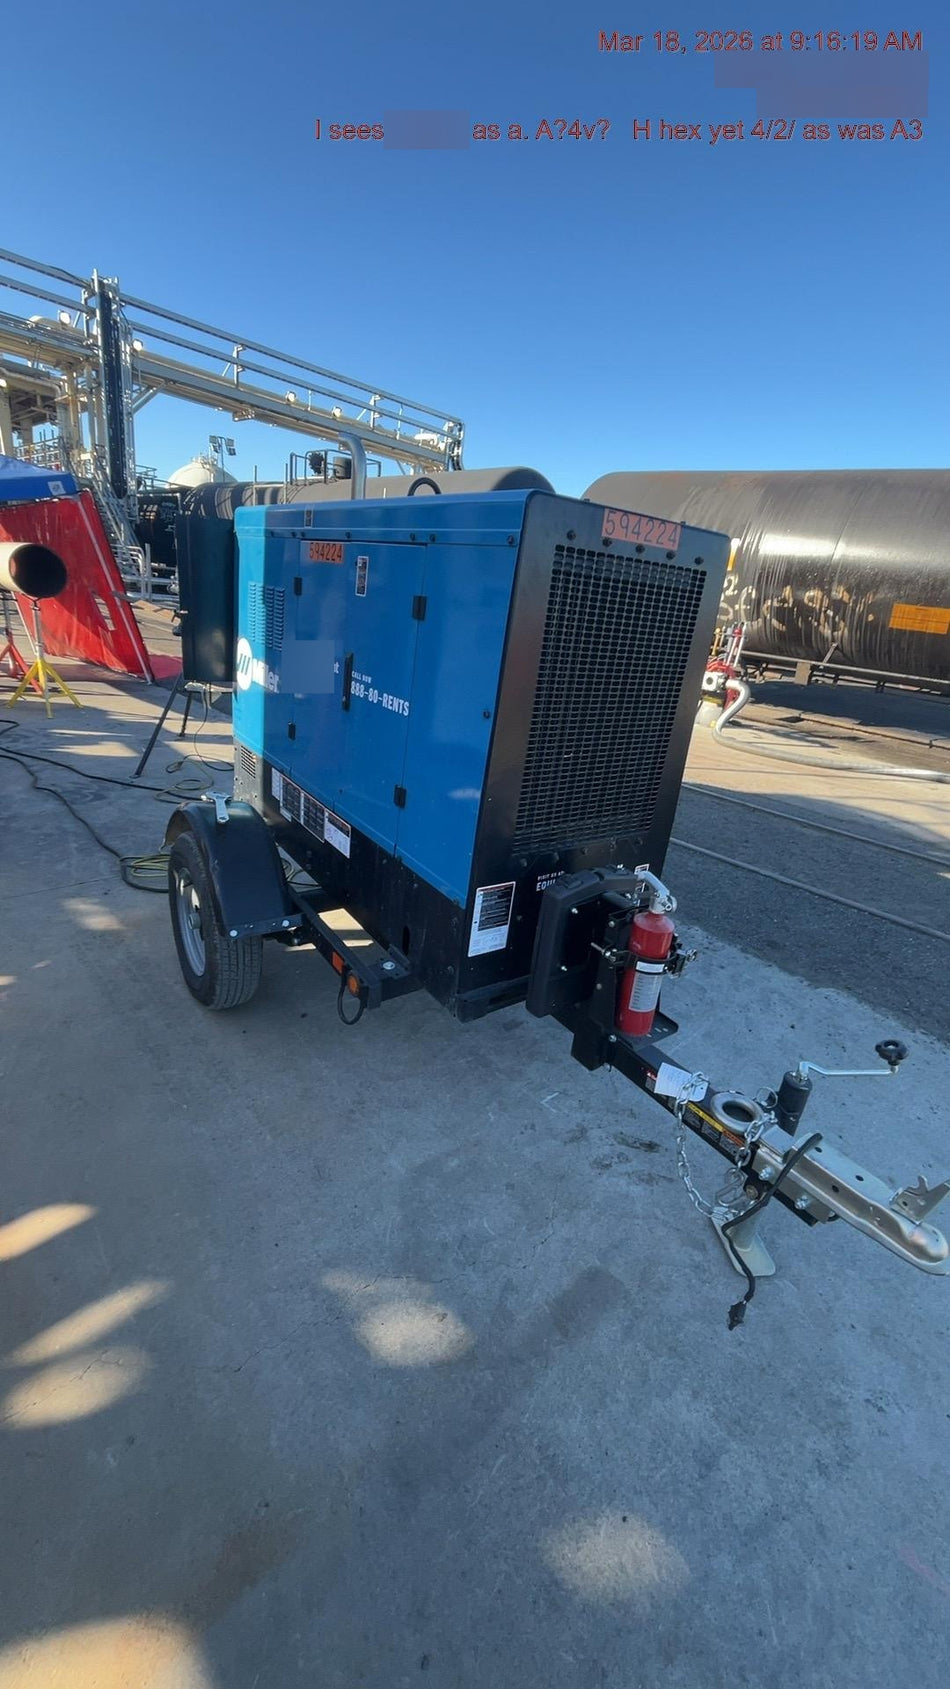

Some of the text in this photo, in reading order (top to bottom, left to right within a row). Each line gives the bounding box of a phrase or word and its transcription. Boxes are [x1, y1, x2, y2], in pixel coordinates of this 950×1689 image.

[605, 510, 679, 548] 594224
[309, 541, 343, 562] 594224
[351, 680, 410, 717] 888-80-RENTS
